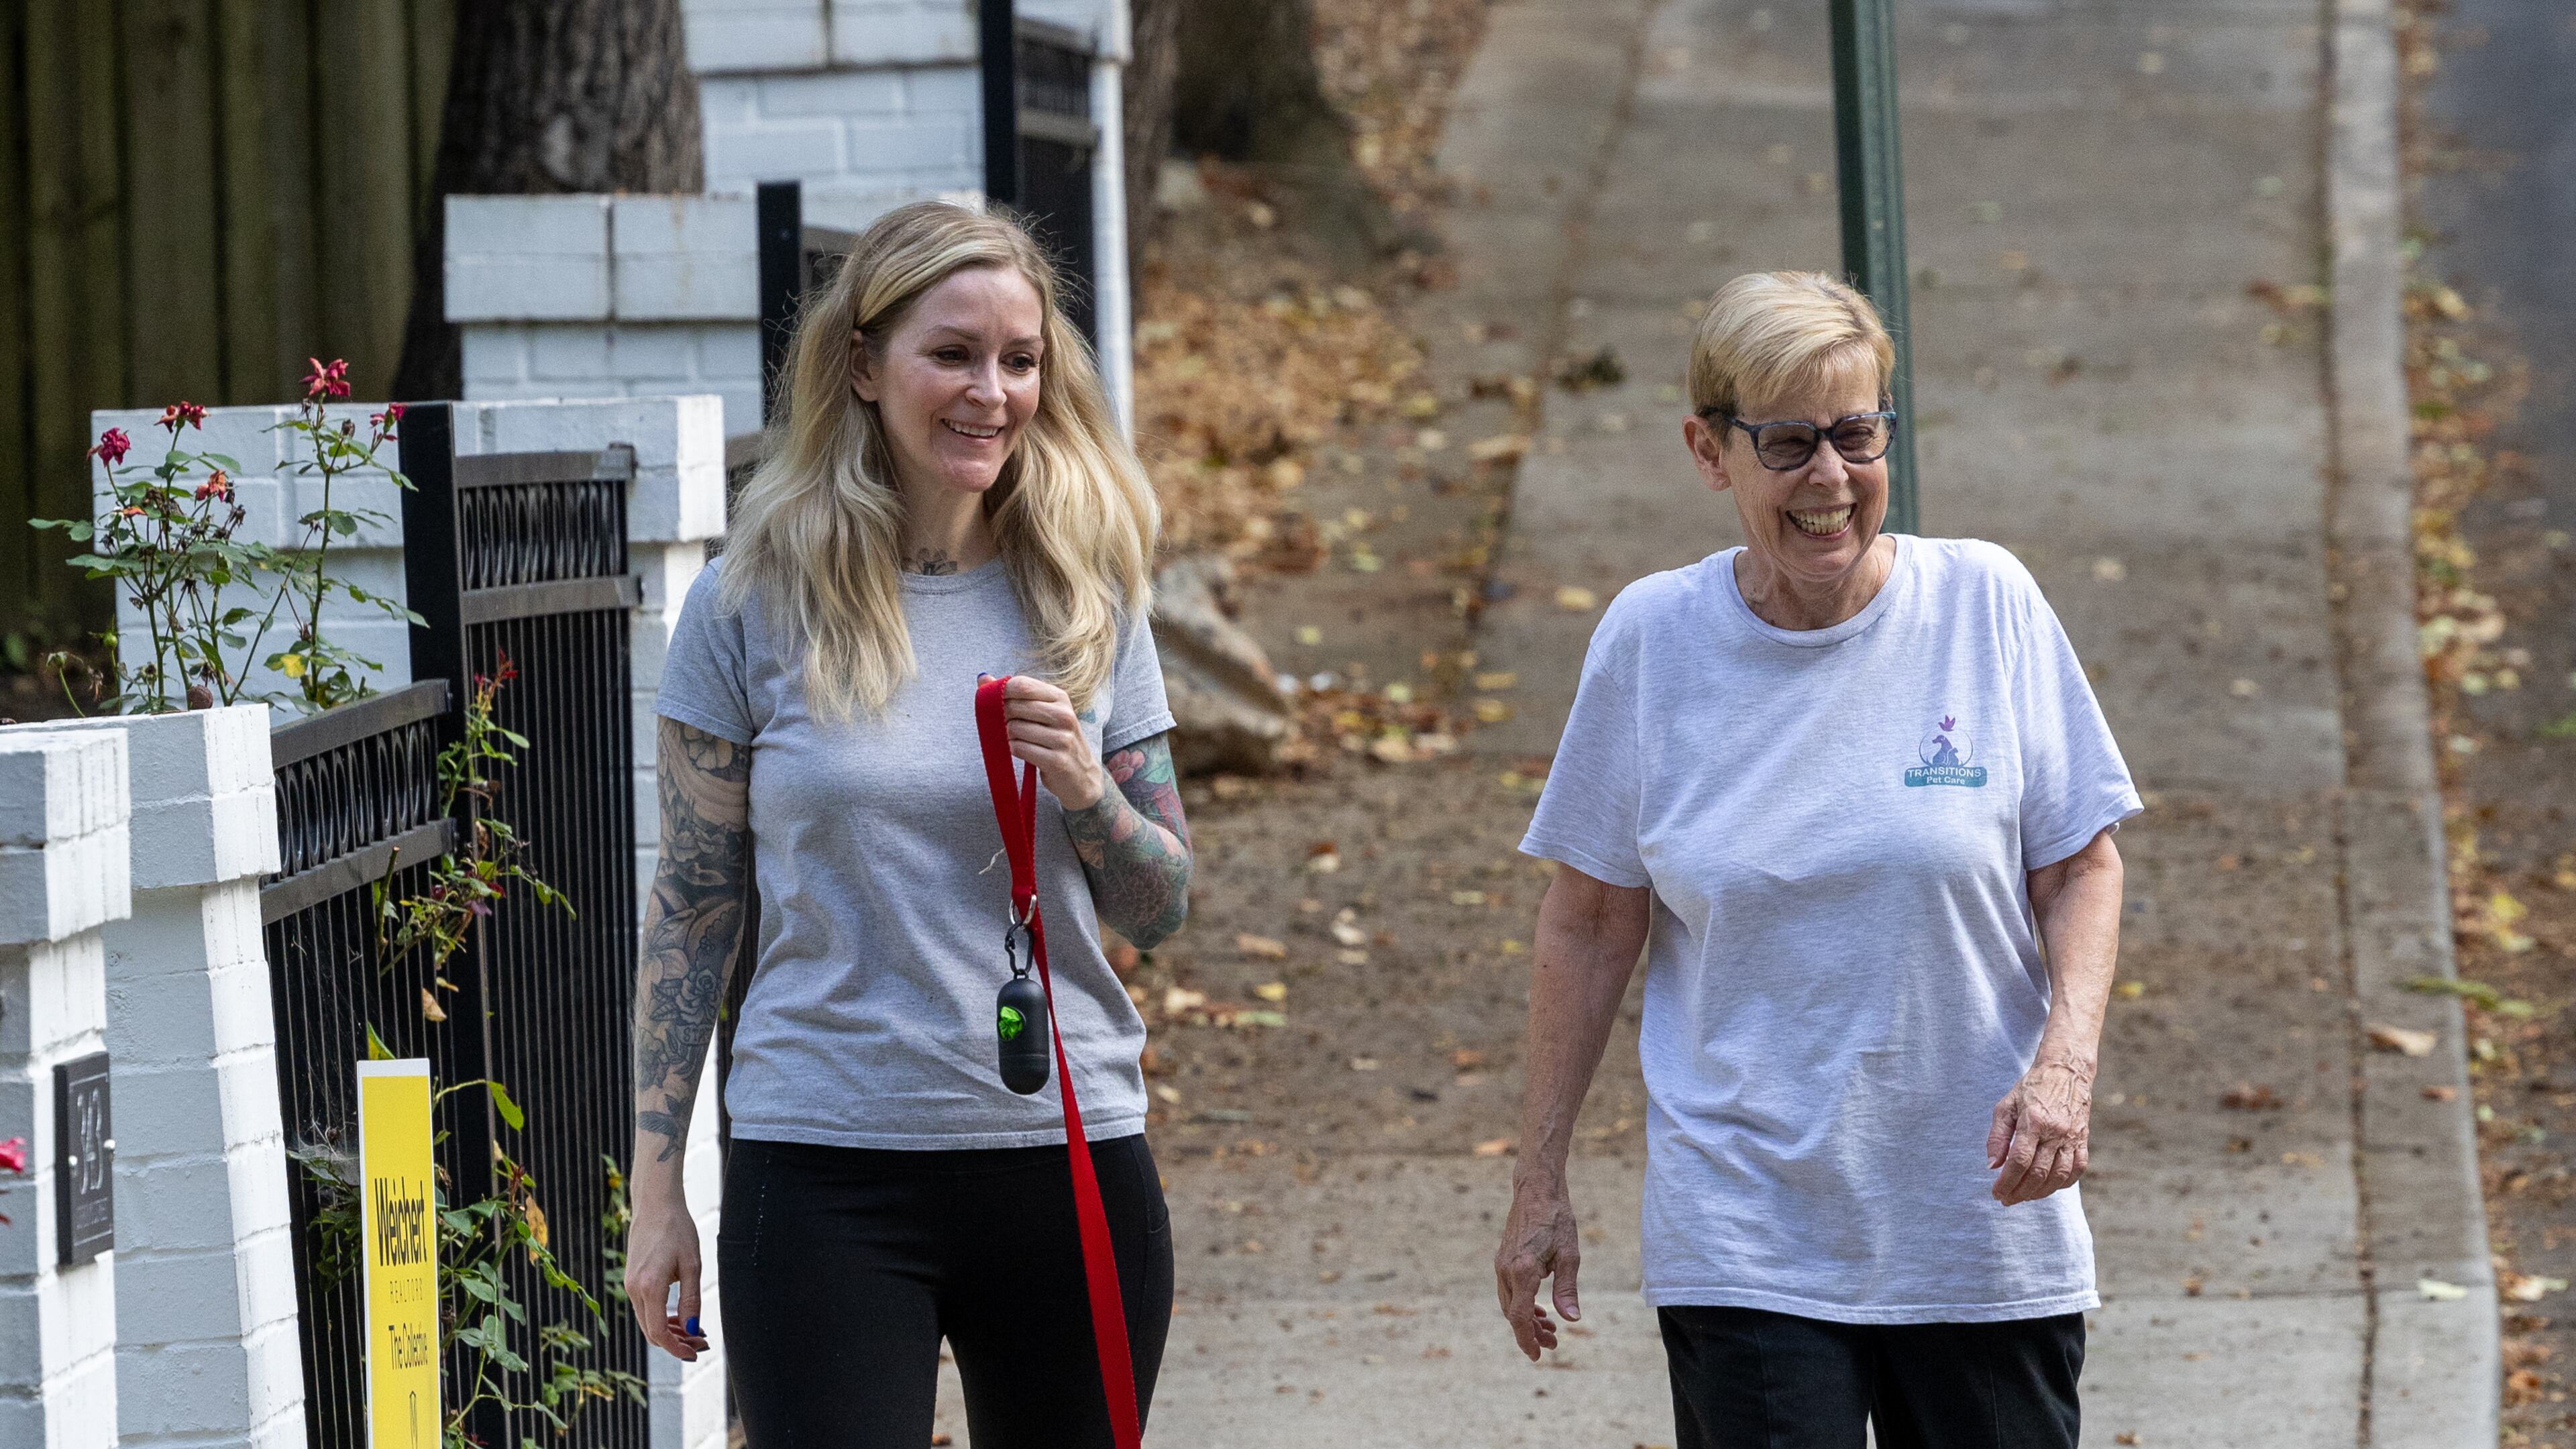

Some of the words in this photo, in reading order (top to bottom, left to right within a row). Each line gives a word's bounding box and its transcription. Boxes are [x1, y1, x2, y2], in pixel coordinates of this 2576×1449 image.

[1907, 767, 1981, 777] TRANSITIONS
[1944, 776, 1966, 784] Care
[374, 1176, 427, 1267] Weichert
[390, 1277, 423, 1303] REALTORS
[388, 1325, 402, 1370] The
[402, 1322, 428, 1369] Collective
